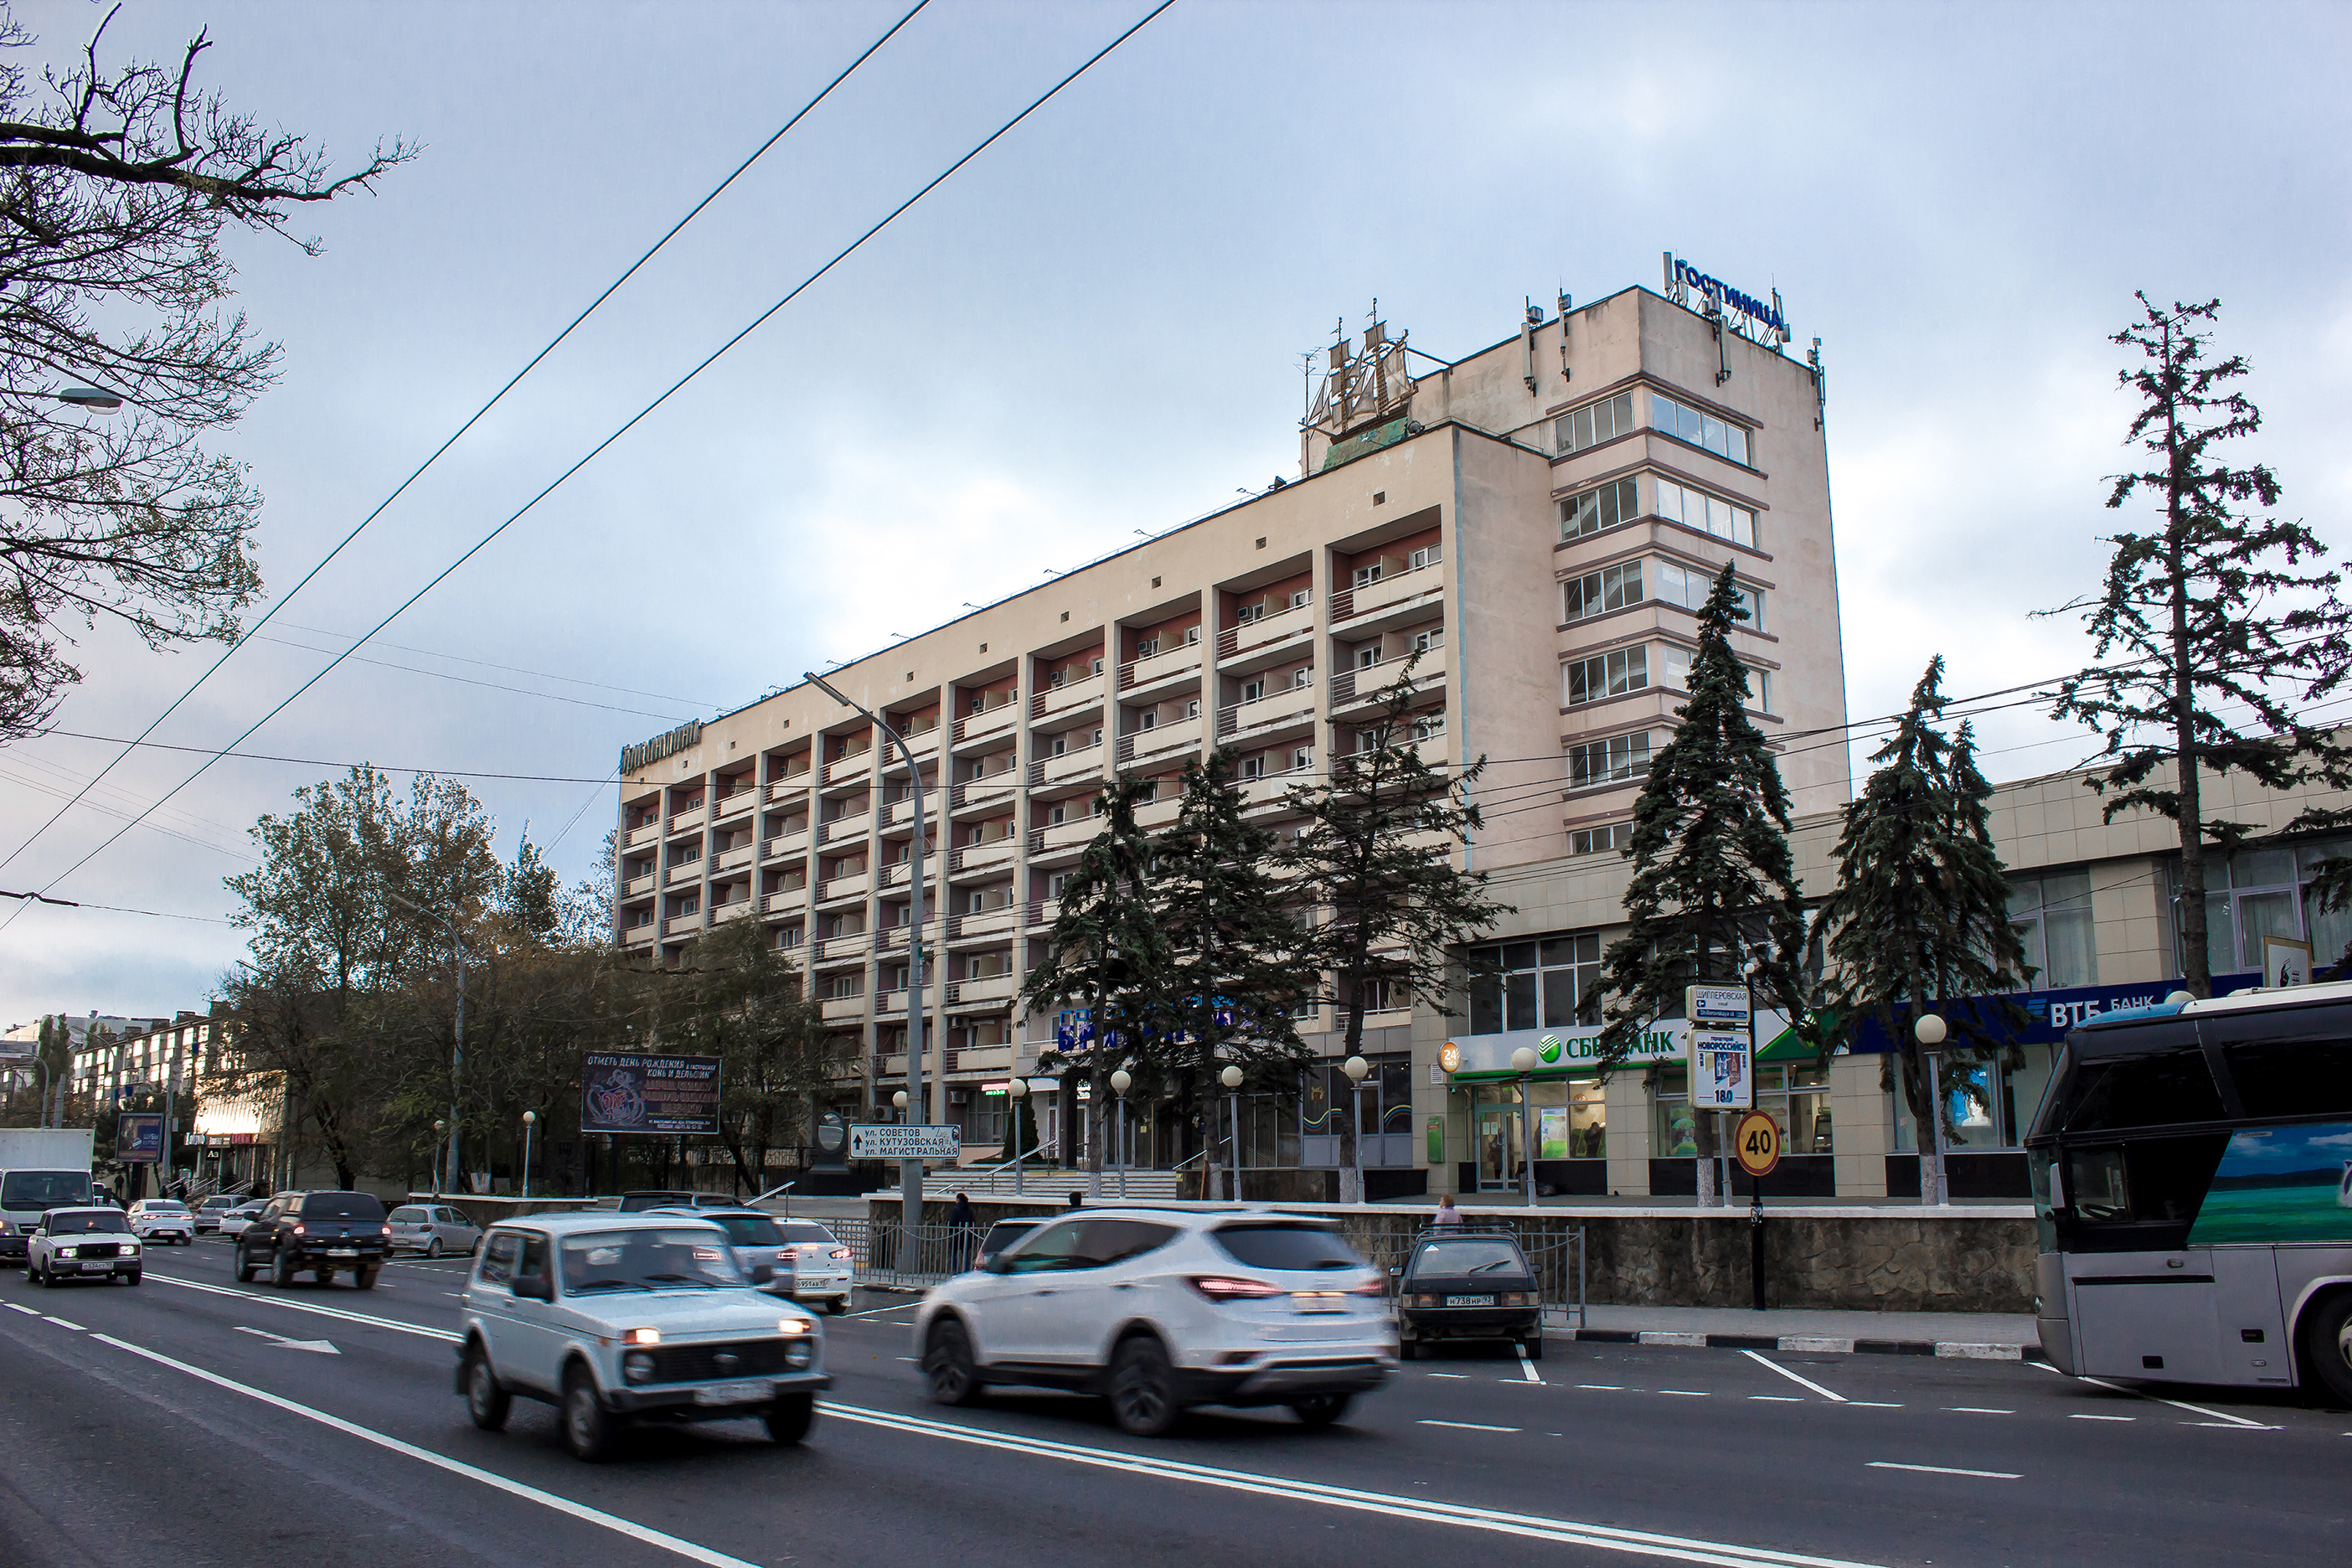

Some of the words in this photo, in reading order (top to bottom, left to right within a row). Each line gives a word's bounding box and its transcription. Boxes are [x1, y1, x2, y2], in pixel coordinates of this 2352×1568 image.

[1674, 259, 1784, 331] ГОСТИНИЦА
[2050, 999, 2102, 1028] ВТБ
[2110, 995, 2154, 1010] БАНК
[1565, 1030, 1676, 1058] СБЕАНК
[1697, 1041, 1747, 1051] НОВОРОССИЙСК
[1443, 1049, 1457, 1060] 24
[587, 1055, 618, 1065] ОТМЕТЬ
[618, 1056, 641, 1067] ДЕНЬ
[642, 1058, 685, 1069] РОЖДЕНИЯ
[668, 1069, 674, 1078] И
[1715, 1089, 1734, 1102] 180
[865, 1129, 877, 1137] ул.
[879, 1127, 921, 1137] СОВЕТОВ
[865, 1138, 877, 1147] ул.
[879, 1137, 944, 1146] КУТУЗОВСКАЯ
[1745, 1130, 1771, 1155] 40
[865, 1148, 877, 1156] ул.
[879, 1147, 957, 1156] МАГИСТРАЛЬНАЯ
